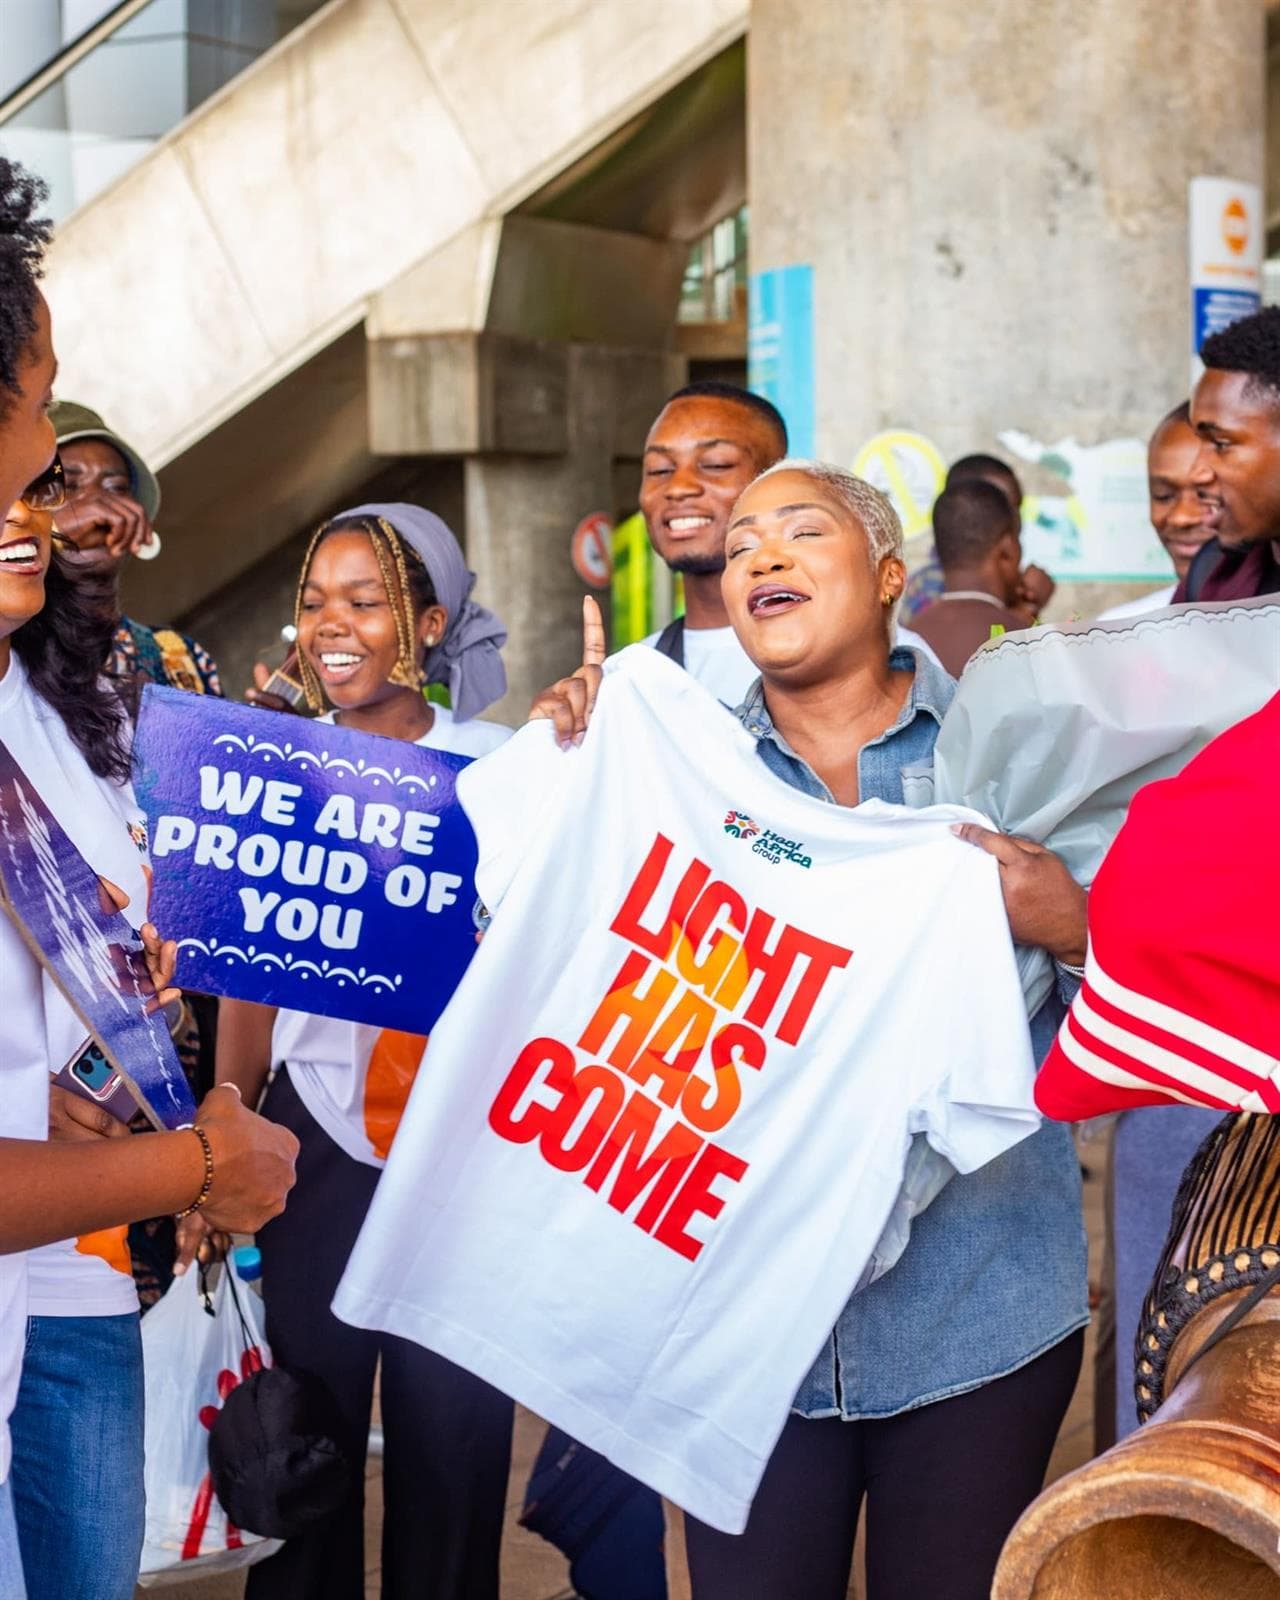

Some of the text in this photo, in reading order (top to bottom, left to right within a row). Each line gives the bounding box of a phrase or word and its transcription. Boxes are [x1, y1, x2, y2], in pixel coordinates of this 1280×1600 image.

[200, 766, 440, 855] WE ARE
[752, 843, 781, 864] Group
[763, 829, 803, 850] Heal
[153, 816, 462, 914] PROUD OF
[238, 888, 363, 949] YOU
[610, 832, 854, 1047] LIGHT
[577, 950, 767, 1133] HAS
[488, 1037, 749, 1262] COME
